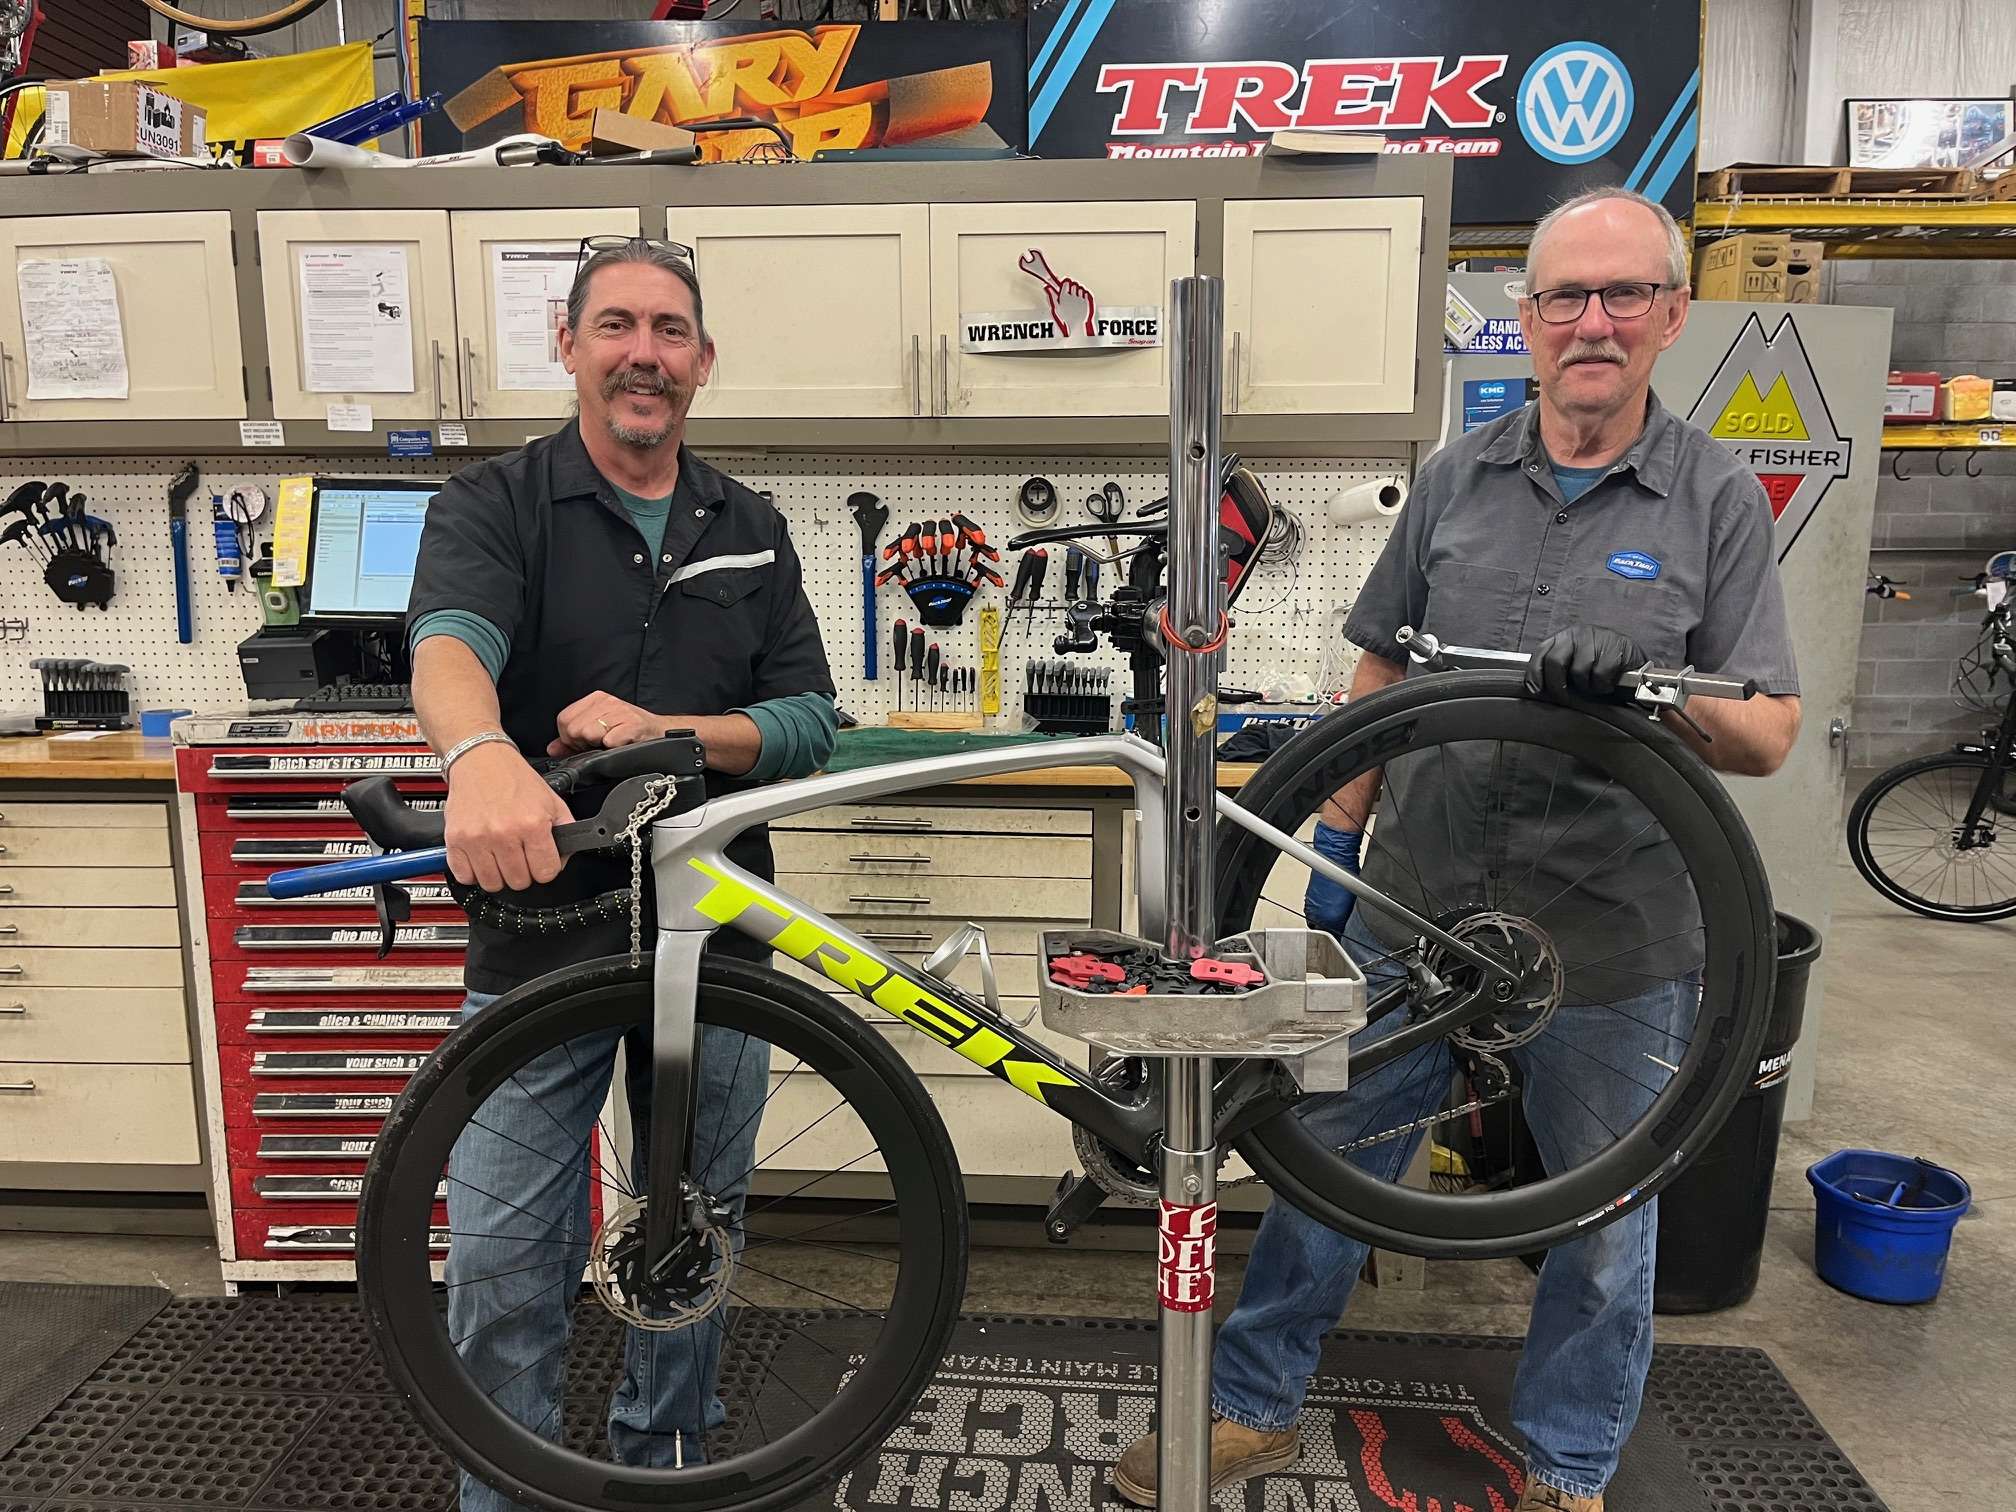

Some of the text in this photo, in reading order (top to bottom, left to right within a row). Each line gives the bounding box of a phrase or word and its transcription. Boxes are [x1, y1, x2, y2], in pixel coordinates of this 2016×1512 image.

[526, 25, 862, 150] GARY
[1096, 55, 1509, 135] TREK
[140, 126, 178, 151] UN3091
[1421, 138, 1500, 155] Team
[1108, 141, 1247, 158] Mountain
[968, 319, 1157, 341] WRENCH FORCE
[1489, 320, 1521, 335] RAND
[1481, 386, 1505, 394] KMC
[1726, 412, 1794, 433] SOLD
[1750, 449, 1840, 467] FISHER
[303, 723, 418, 737] KRYPTONI
[366, 757, 384, 769] all
[384, 757, 412, 769] BALL
[323, 842, 372, 854] AXLE ros
[331, 928, 428, 942] give me RAKE
[687, 857, 1081, 1106] TREK
[1759, 1051, 1791, 1074] MENA
[942, 1353, 1119, 1378] MAINTENA
[1410, 1381, 1475, 1401] THE
